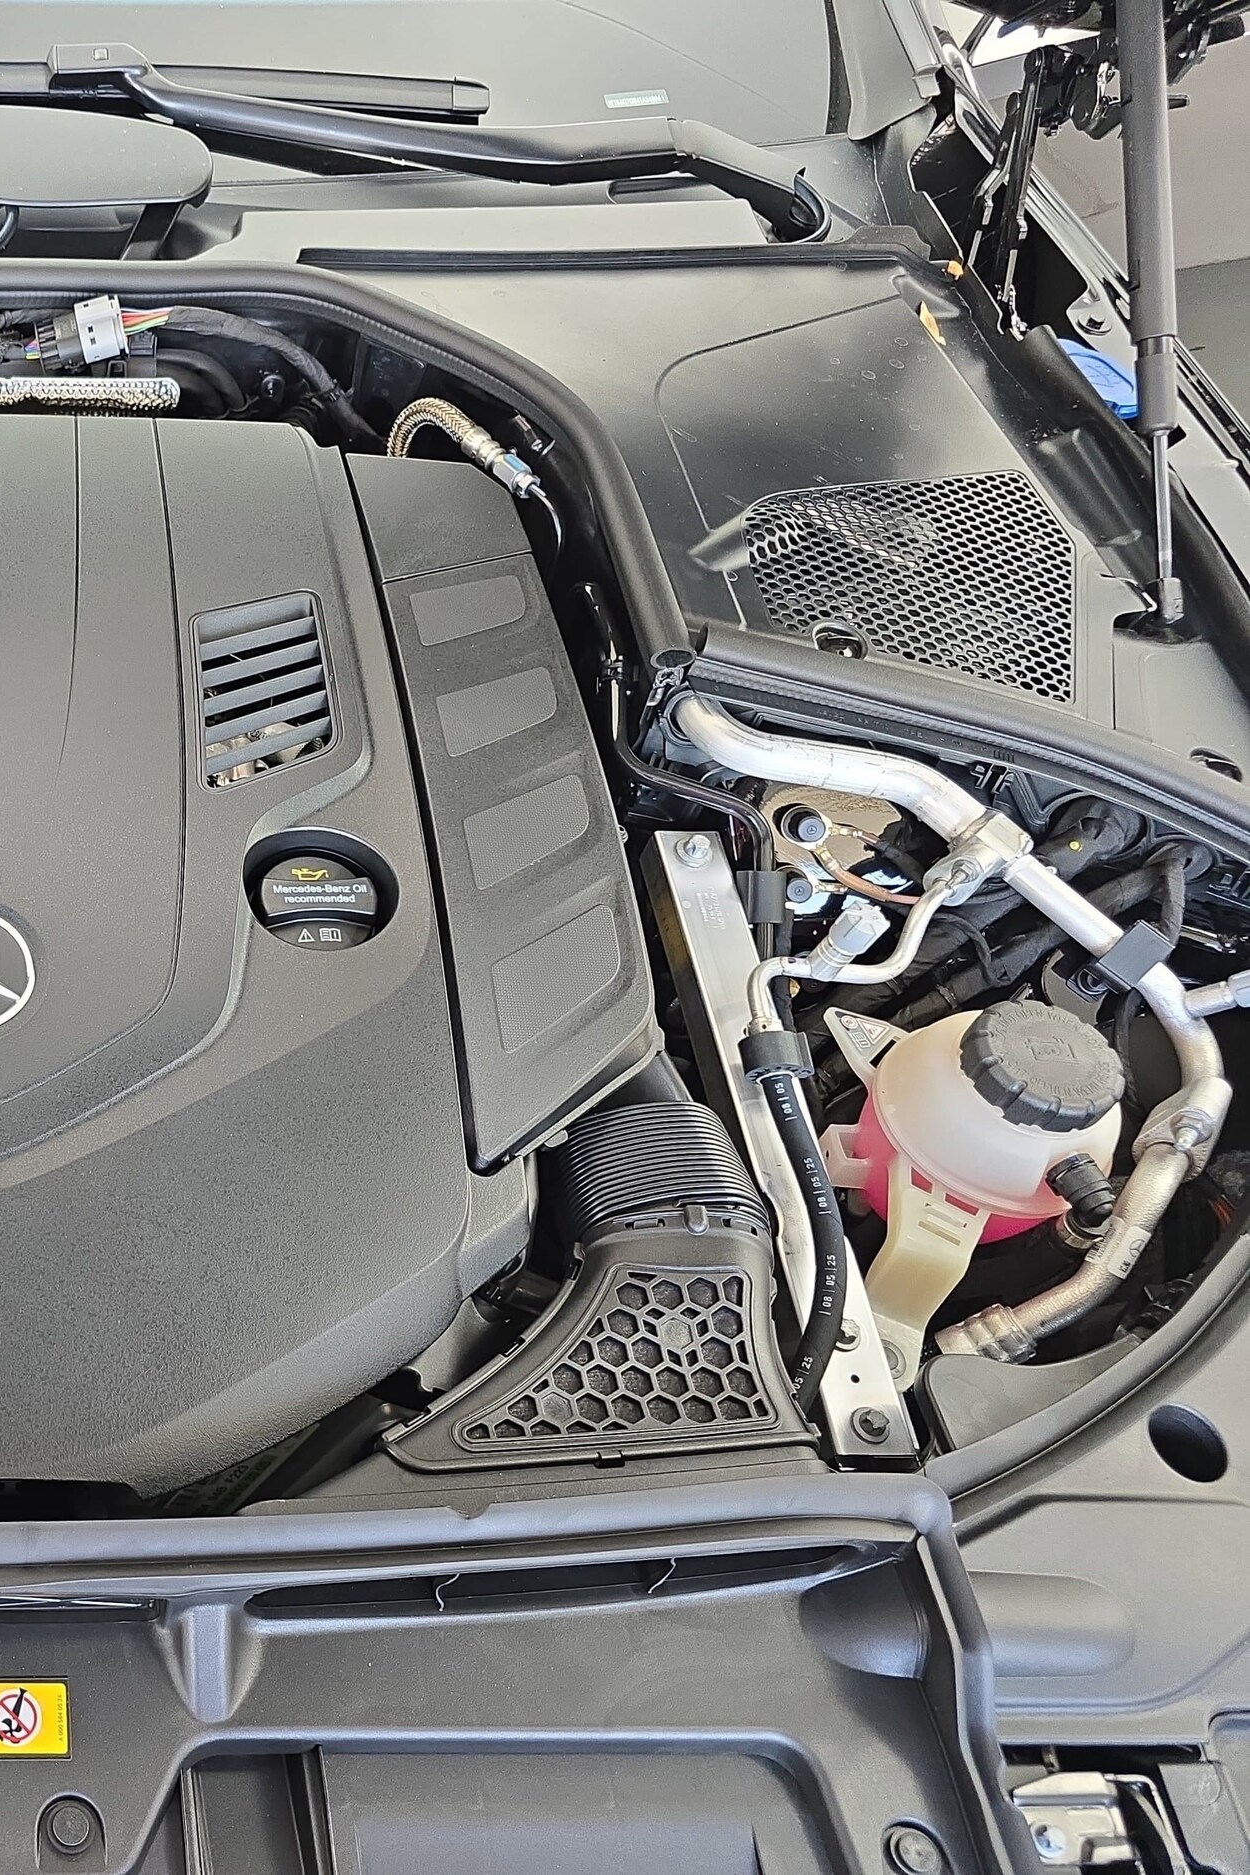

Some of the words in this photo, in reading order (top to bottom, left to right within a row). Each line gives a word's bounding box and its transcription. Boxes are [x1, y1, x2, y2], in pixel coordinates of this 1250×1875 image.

[273, 884, 351, 894] Mercedes-Benz
[352, 884, 368, 893] Oil
[284, 894, 356, 904] recommended
